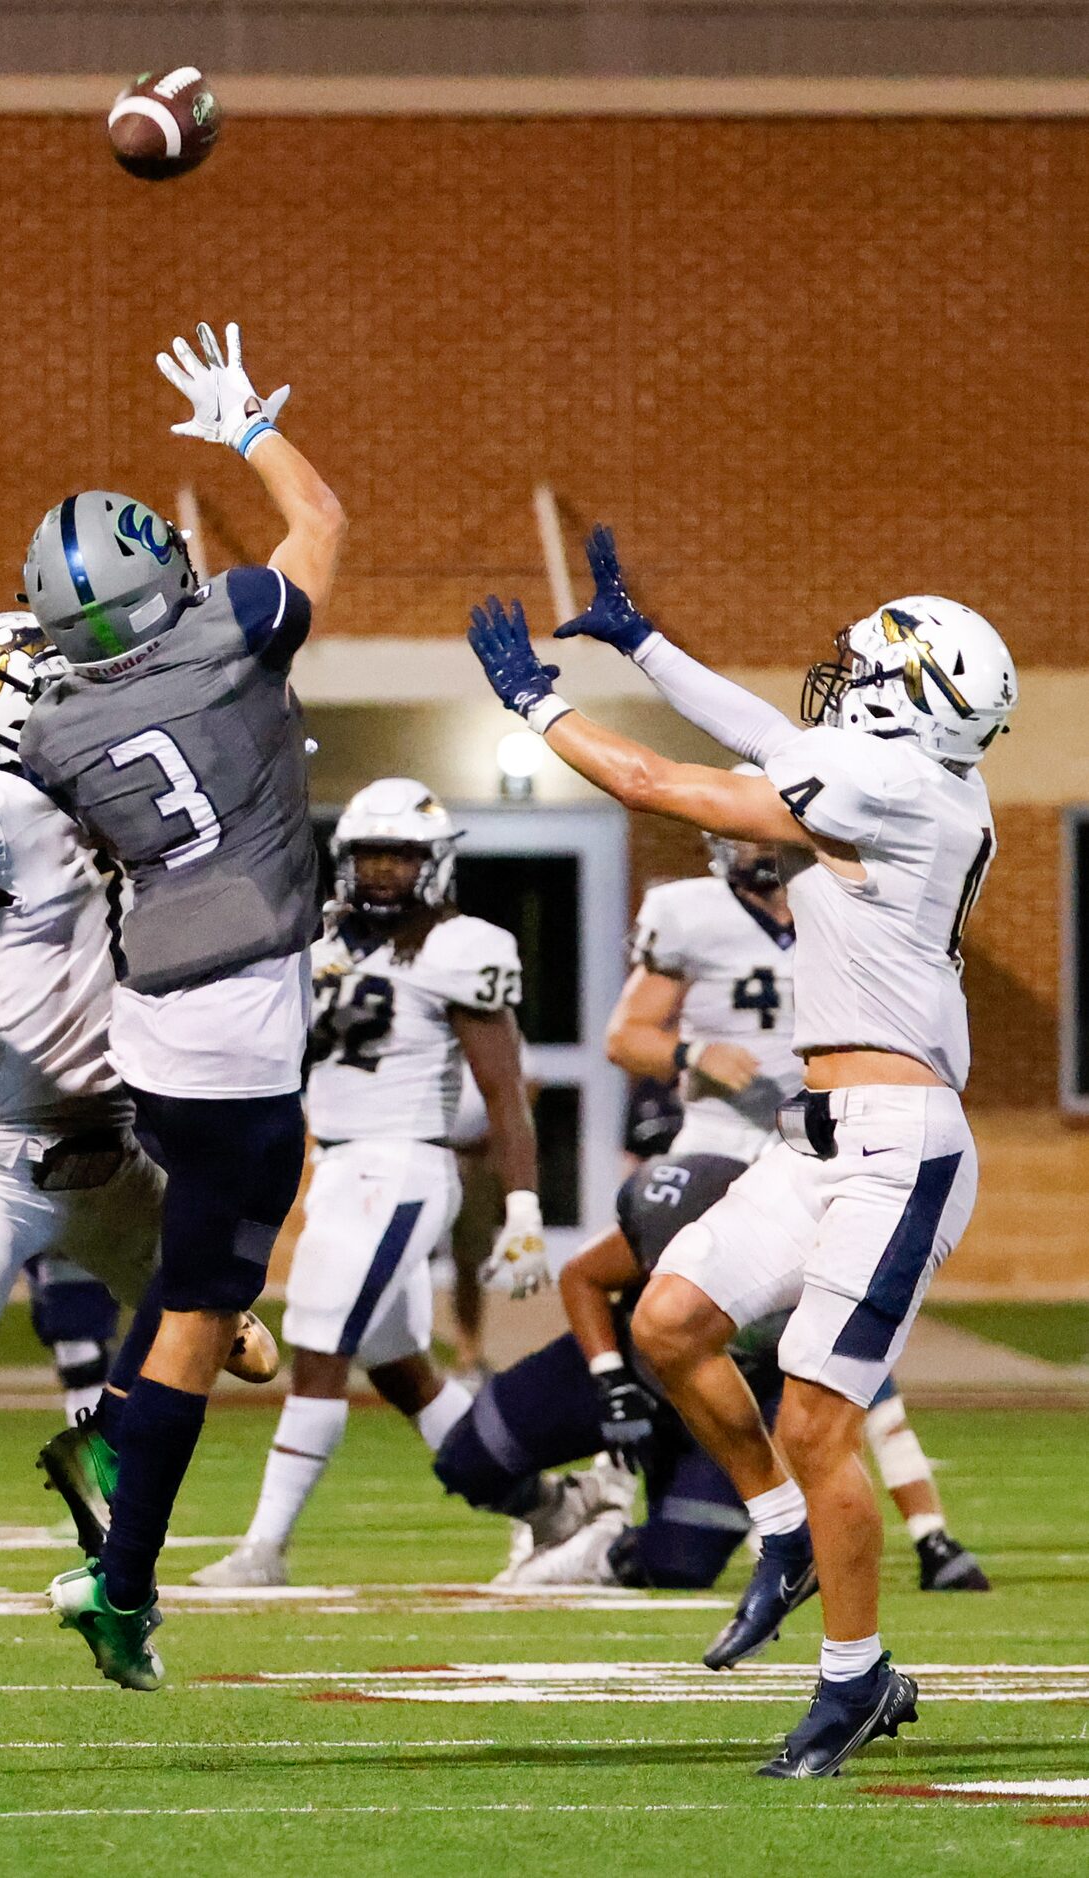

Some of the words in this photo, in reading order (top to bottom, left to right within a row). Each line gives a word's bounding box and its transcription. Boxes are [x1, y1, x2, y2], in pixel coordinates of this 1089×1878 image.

[107, 725, 222, 870] 3
[779, 776, 825, 818] 4
[644, 1165, 691, 1208] 65
